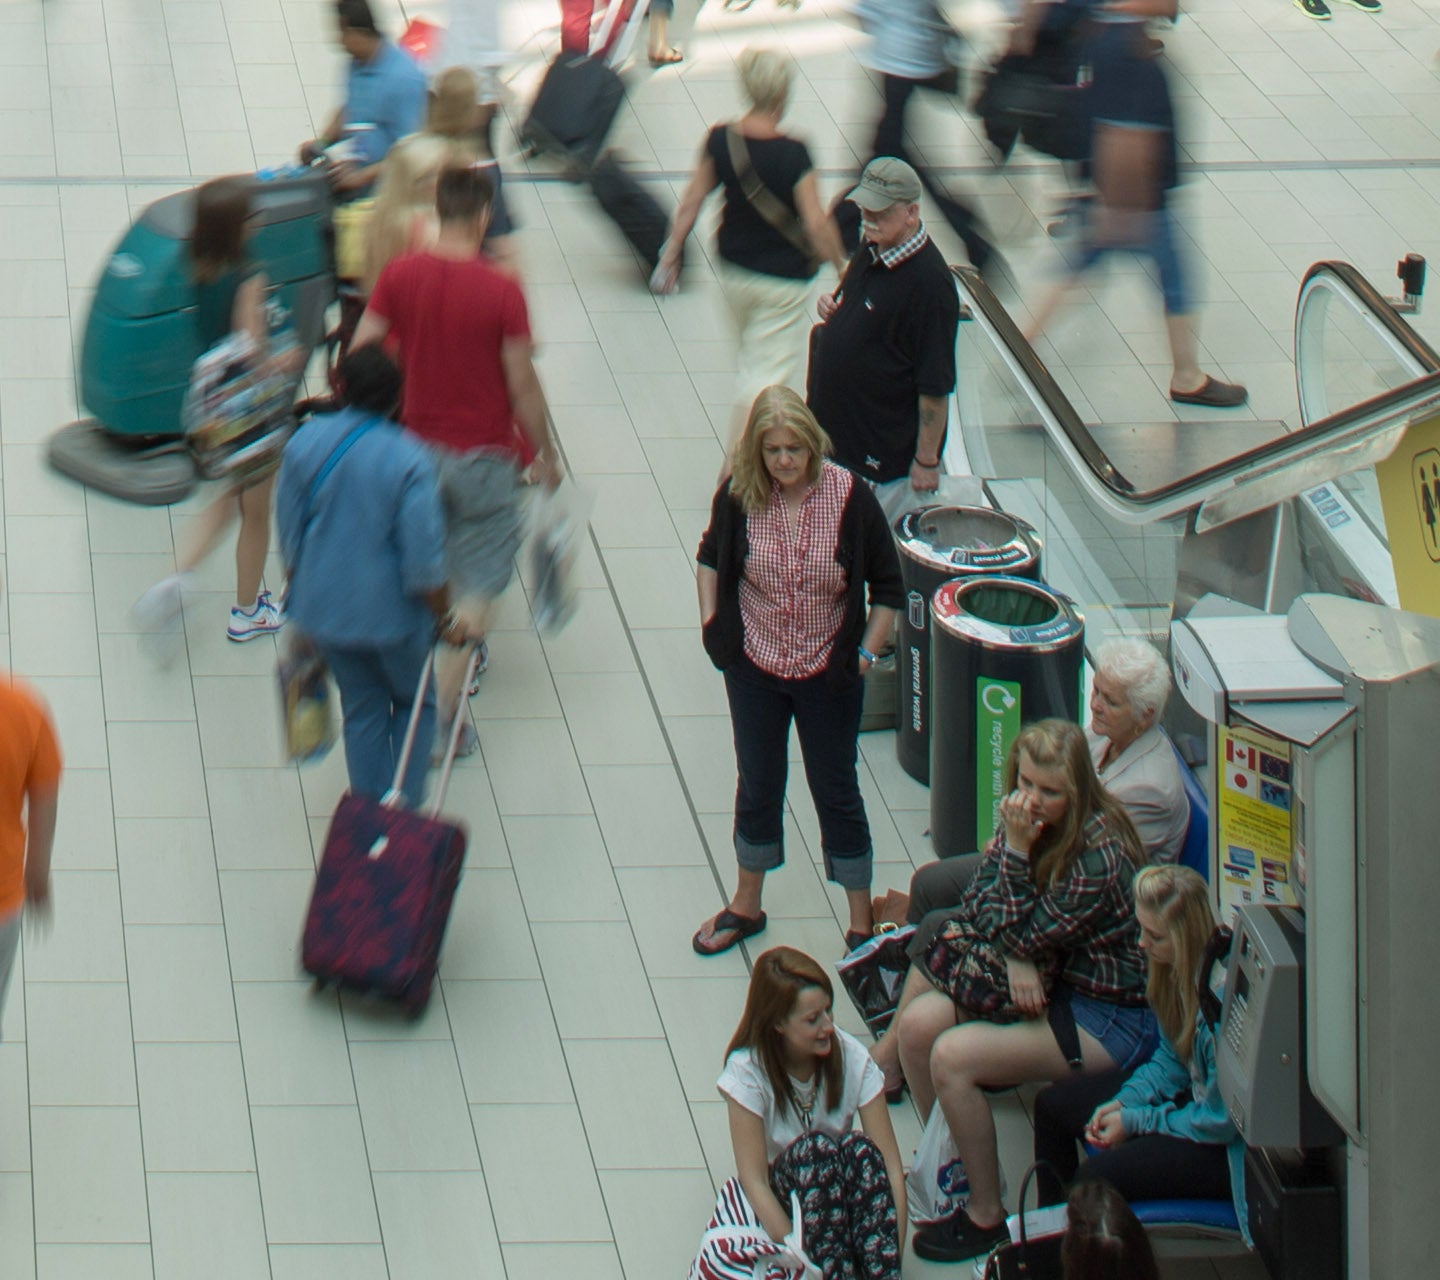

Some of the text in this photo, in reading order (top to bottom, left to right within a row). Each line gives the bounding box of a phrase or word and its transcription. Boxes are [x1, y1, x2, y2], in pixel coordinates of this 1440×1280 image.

[910, 646, 923, 732] general waste
[989, 720, 1003, 766] recycle
